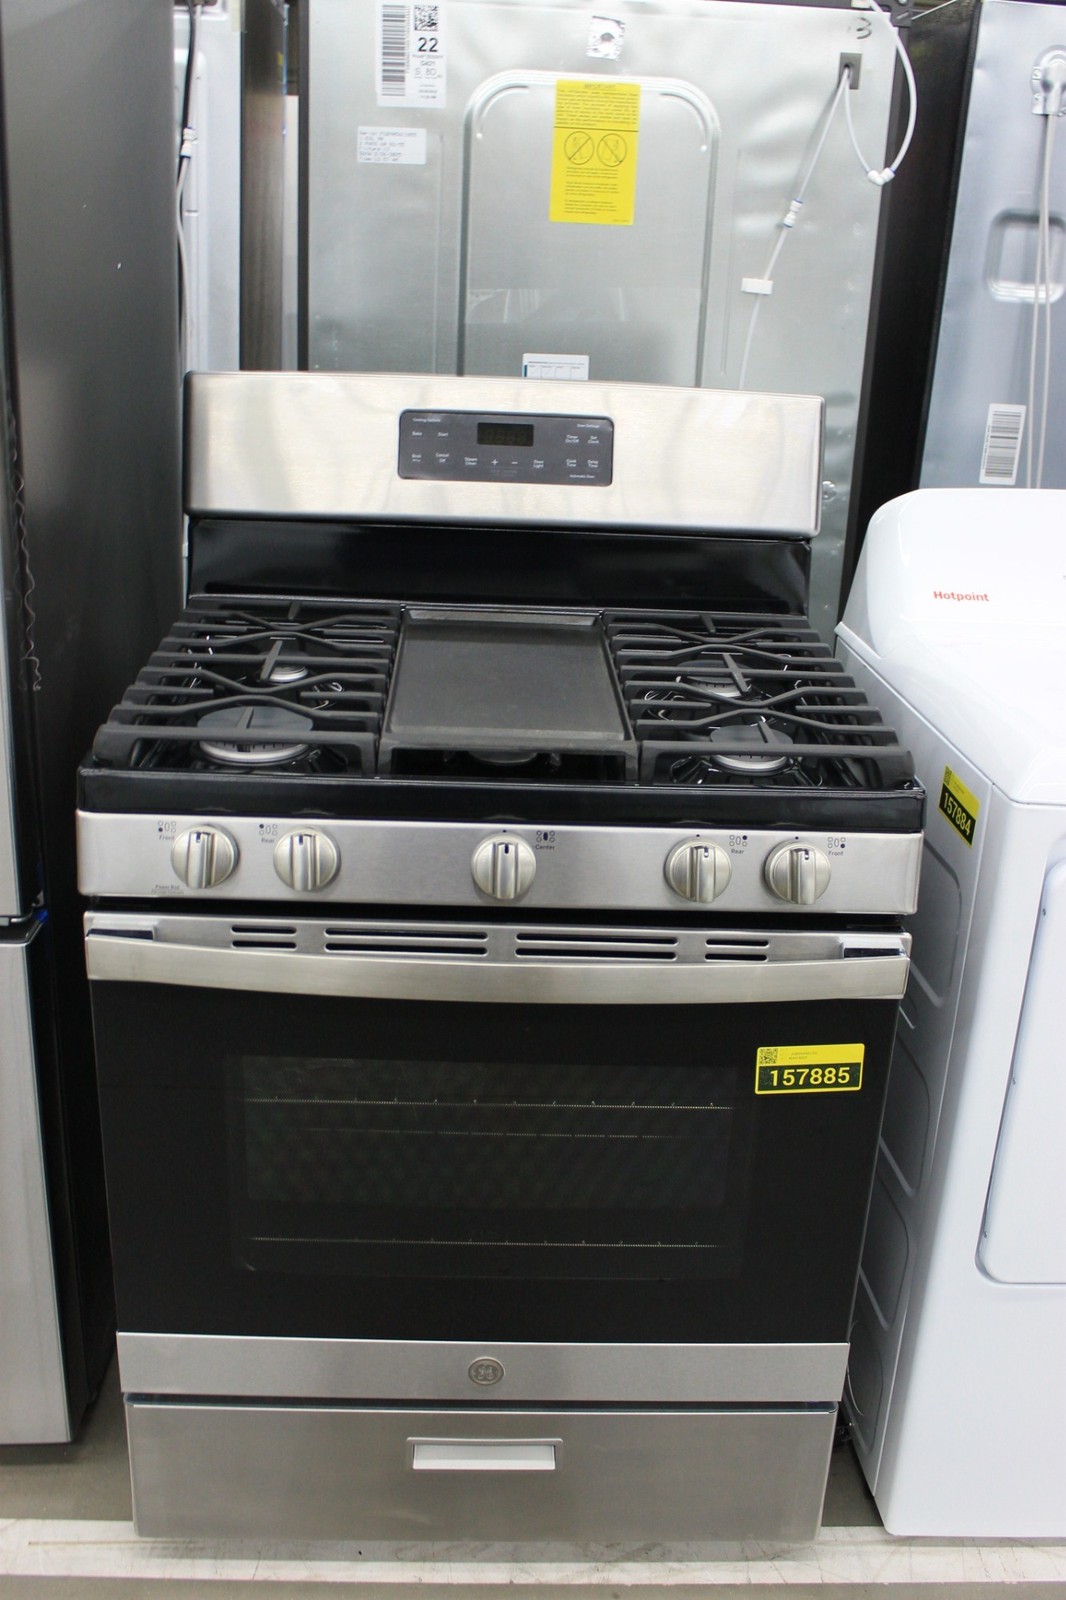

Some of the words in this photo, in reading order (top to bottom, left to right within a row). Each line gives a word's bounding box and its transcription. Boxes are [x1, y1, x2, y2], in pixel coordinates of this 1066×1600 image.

[418, 37, 438, 52] 22
[933, 591, 989, 602] Hotpoint
[944, 792, 971, 836] 157884
[770, 1067, 850, 1086] 157885
